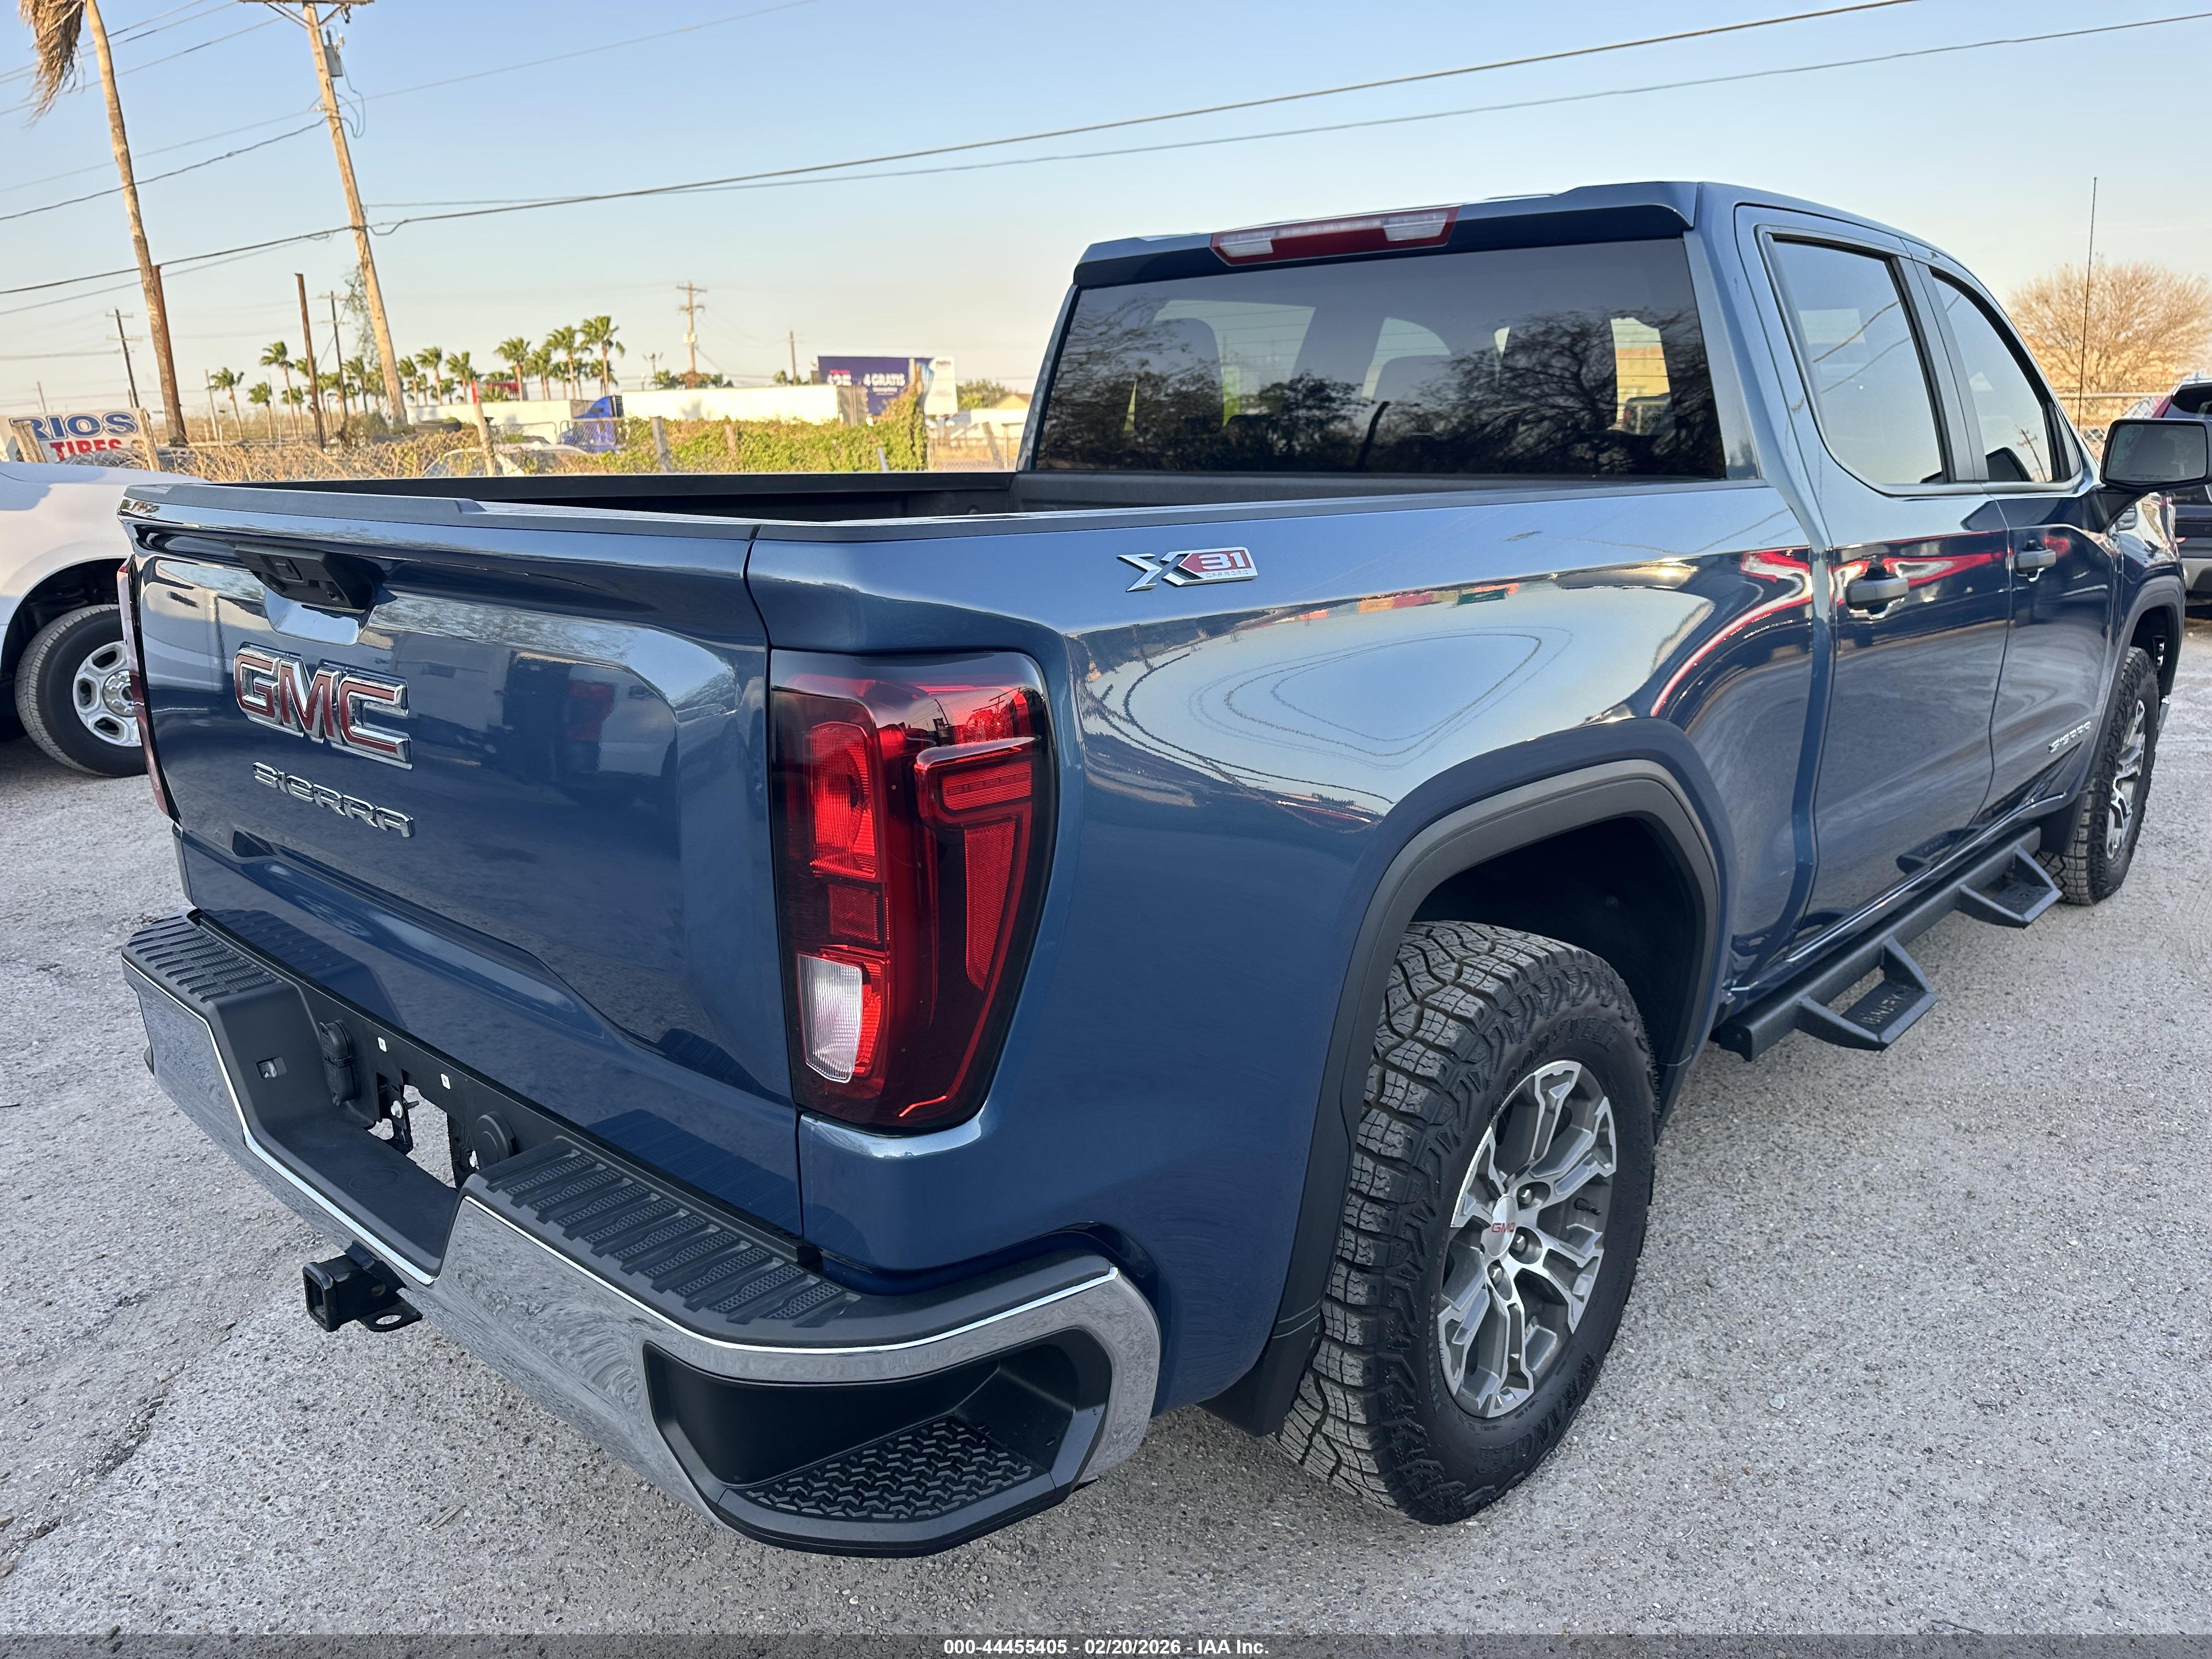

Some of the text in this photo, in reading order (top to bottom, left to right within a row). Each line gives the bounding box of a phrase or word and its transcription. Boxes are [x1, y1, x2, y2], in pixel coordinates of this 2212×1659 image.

[871, 373, 906, 387] GRATIS
[9, 411, 138, 441] RIOS
[233, 642, 413, 770] GMC
[252, 761, 415, 838] SIERRA
[1491, 1222, 1516, 1233] GMC
